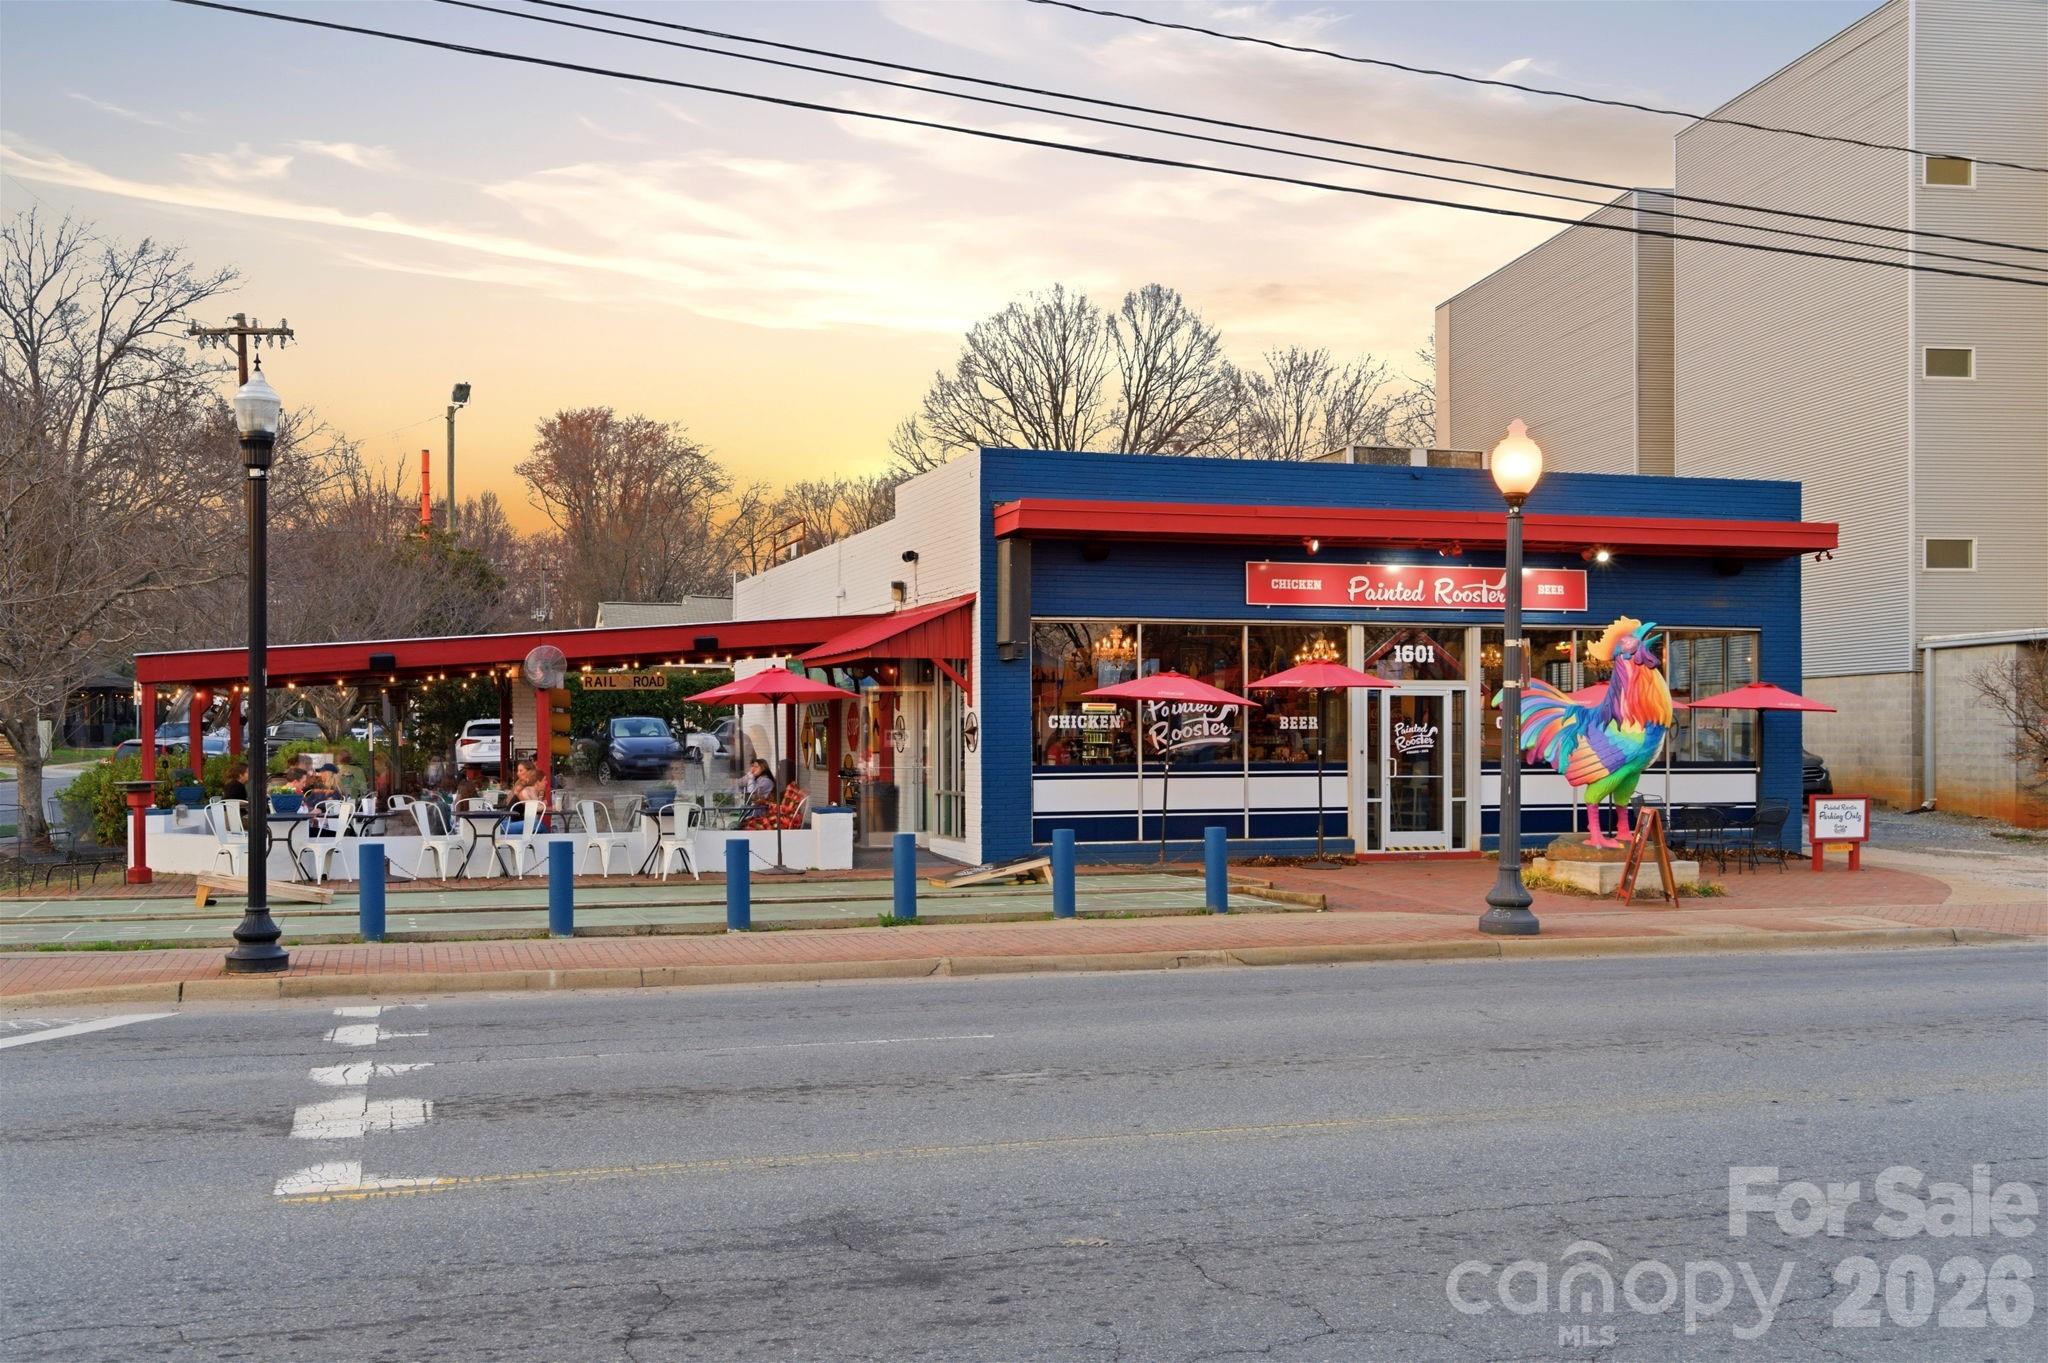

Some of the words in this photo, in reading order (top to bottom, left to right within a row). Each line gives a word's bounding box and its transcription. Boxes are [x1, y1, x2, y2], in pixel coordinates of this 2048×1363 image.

[1271, 578, 1322, 590] CHICKEN
[1348, 575, 1425, 603] Painted
[1434, 573, 1506, 604] Rooster
[1537, 584, 1565, 595] BEER
[1394, 645, 1435, 663] 1601
[585, 676, 617, 688] RAIL
[633, 676, 665, 687] ROAD
[1048, 715, 1121, 729] CHICKEN
[1279, 716, 1318, 730] BEER
[1394, 722, 1427, 737] Painted
[1149, 713, 1233, 750] Rooster
[1395, 732, 1434, 750] Rooster
[1819, 811, 1843, 822] Parking
[1844, 810, 1861, 822] Only
